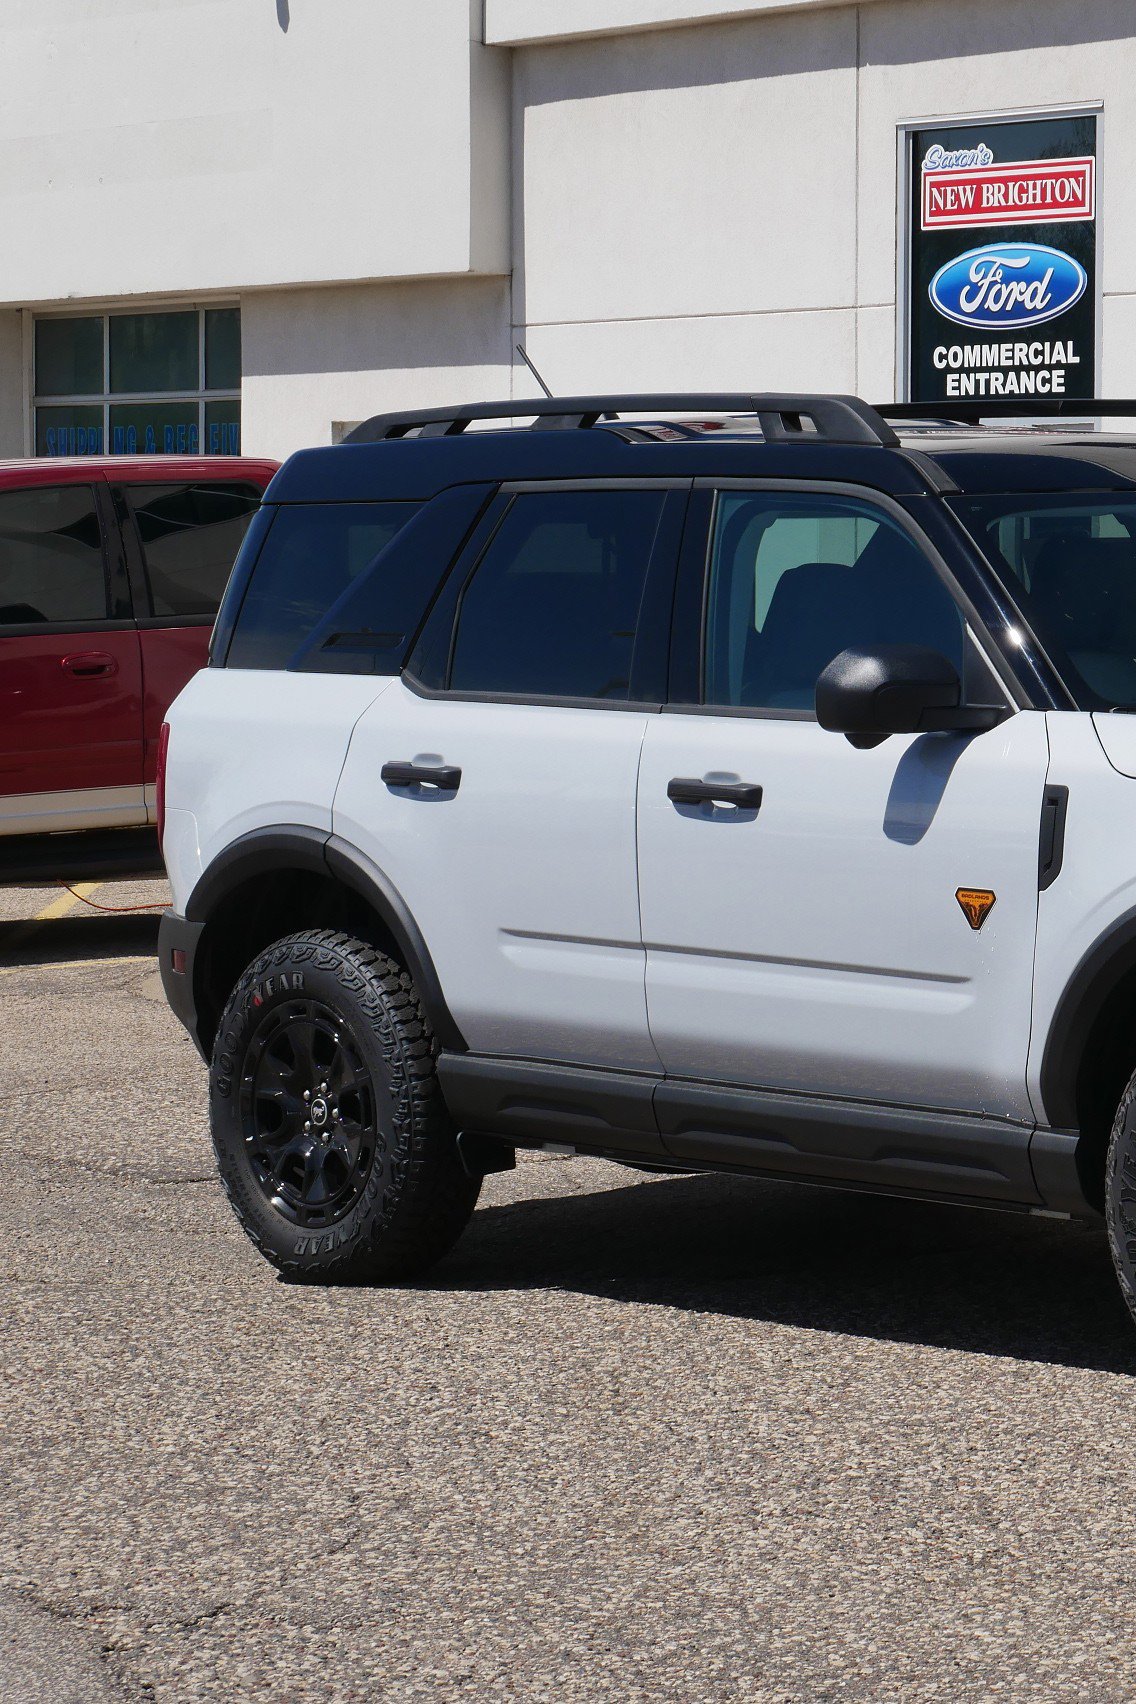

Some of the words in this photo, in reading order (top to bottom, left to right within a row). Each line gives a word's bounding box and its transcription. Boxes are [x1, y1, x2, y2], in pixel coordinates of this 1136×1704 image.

[925, 146, 990, 170] Saxon's
[931, 185, 976, 211] NEW
[981, 177, 1084, 208] BRIGHTON
[960, 256, 1055, 313] Ford
[933, 341, 1080, 369] COMMERCIAL
[946, 370, 1066, 396] ENTRANCE
